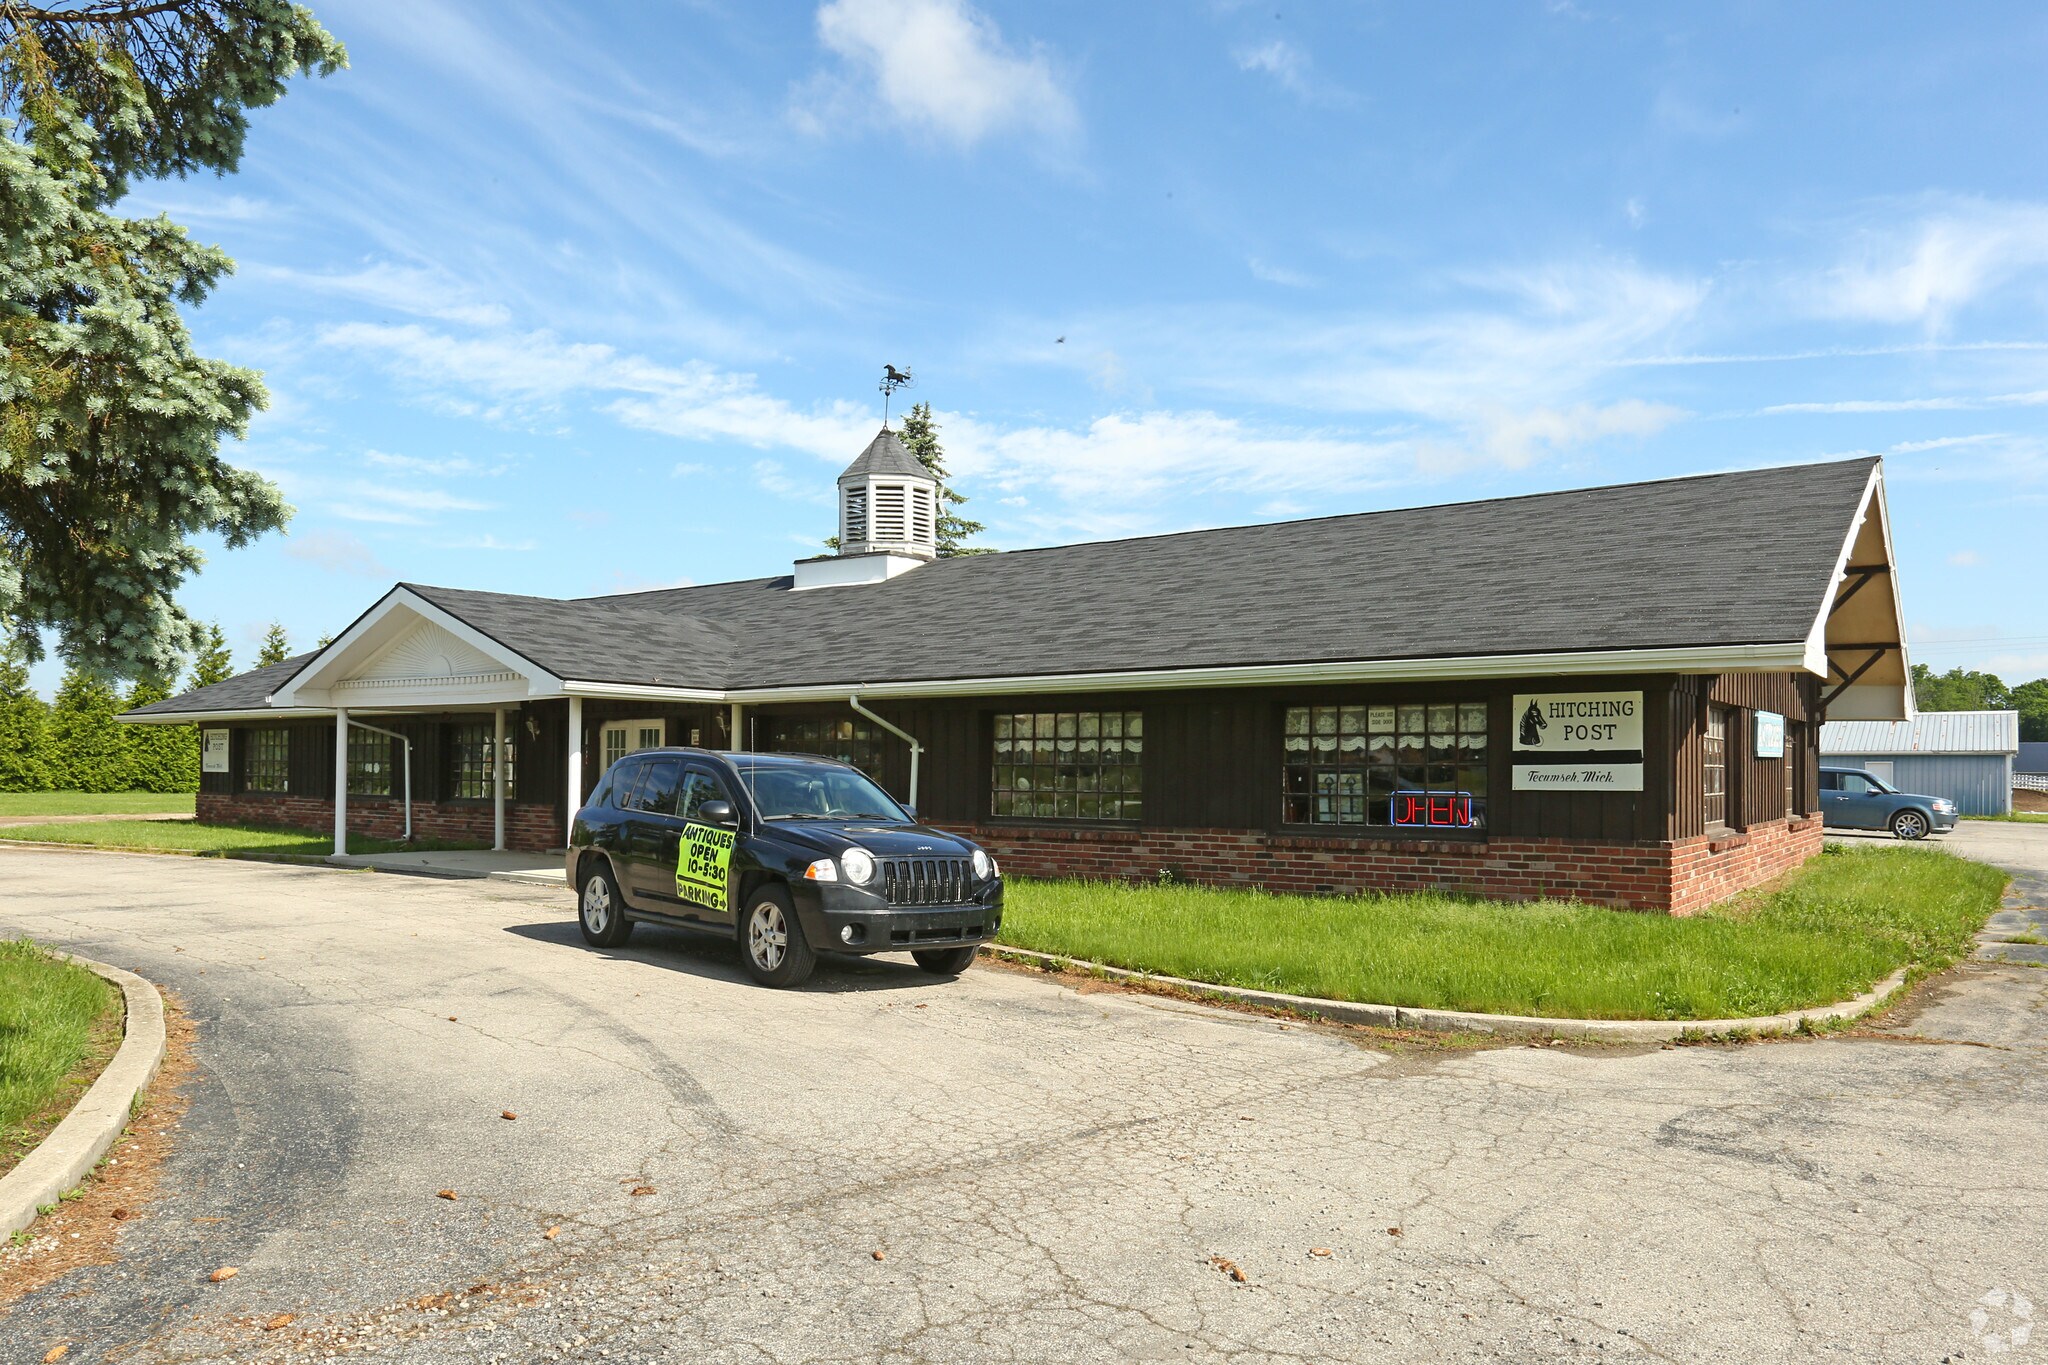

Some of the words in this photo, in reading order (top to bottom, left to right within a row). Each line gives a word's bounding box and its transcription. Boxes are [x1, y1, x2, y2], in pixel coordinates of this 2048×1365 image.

[1549, 700, 1634, 718] HITCHING
[1564, 724, 1617, 741] POST
[1581, 770, 1615, 783] Mich.
[682, 825, 733, 849] ANTIQUES
[690, 843, 718, 863] OPEN
[688, 858, 726, 882] 10-5:30
[677, 883, 719, 908] PARKING
